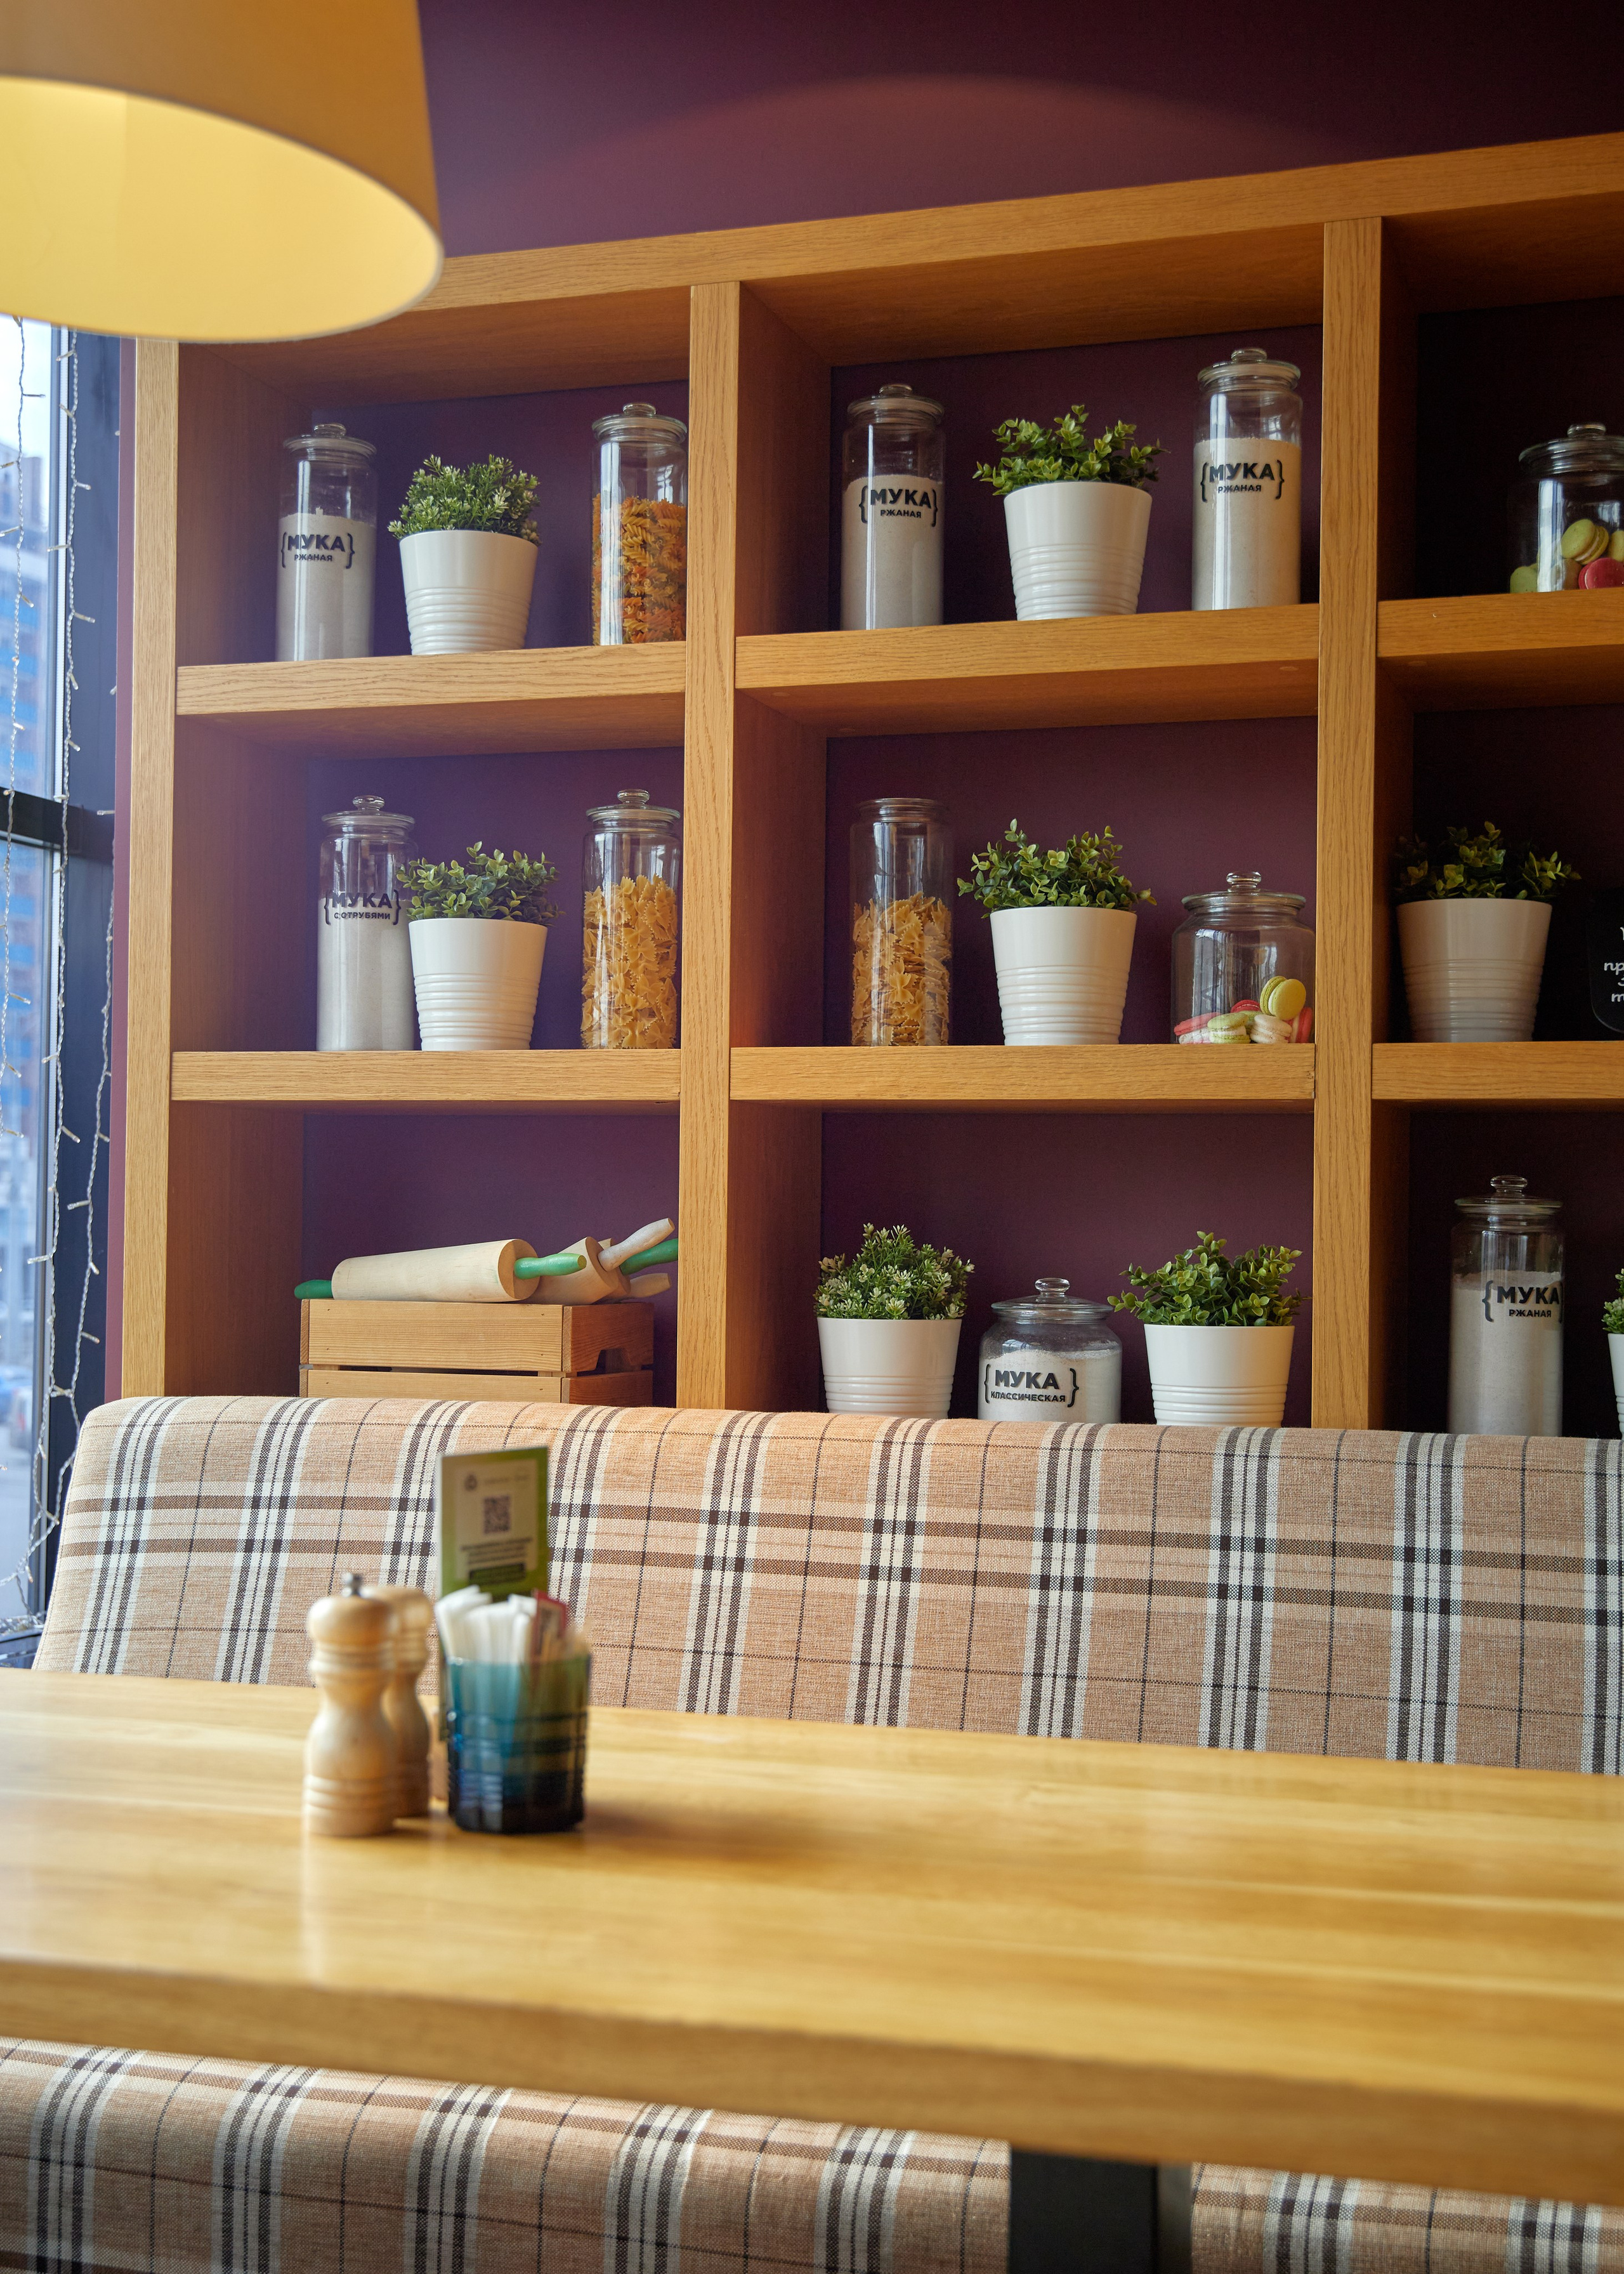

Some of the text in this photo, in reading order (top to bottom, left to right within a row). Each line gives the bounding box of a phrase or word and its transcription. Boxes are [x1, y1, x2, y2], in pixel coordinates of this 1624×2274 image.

[1208, 463, 1275, 483] МУКА
[1218, 485, 1262, 494] РЖАНАЯ
[870, 489, 932, 509] МУКА
[881, 509, 922, 518] РЖАНАЯ
[287, 534, 346, 552] МУКА
[332, 892, 393, 909] МУКА
[1497, 1285, 1560, 1305] МУКА
[1509, 1309, 1552, 1318] РЖАНАЯ
[995, 1369, 1060, 1390] МУКА
[991, 1391, 1066, 1402] КЛАССИЧЕСКАЯ
